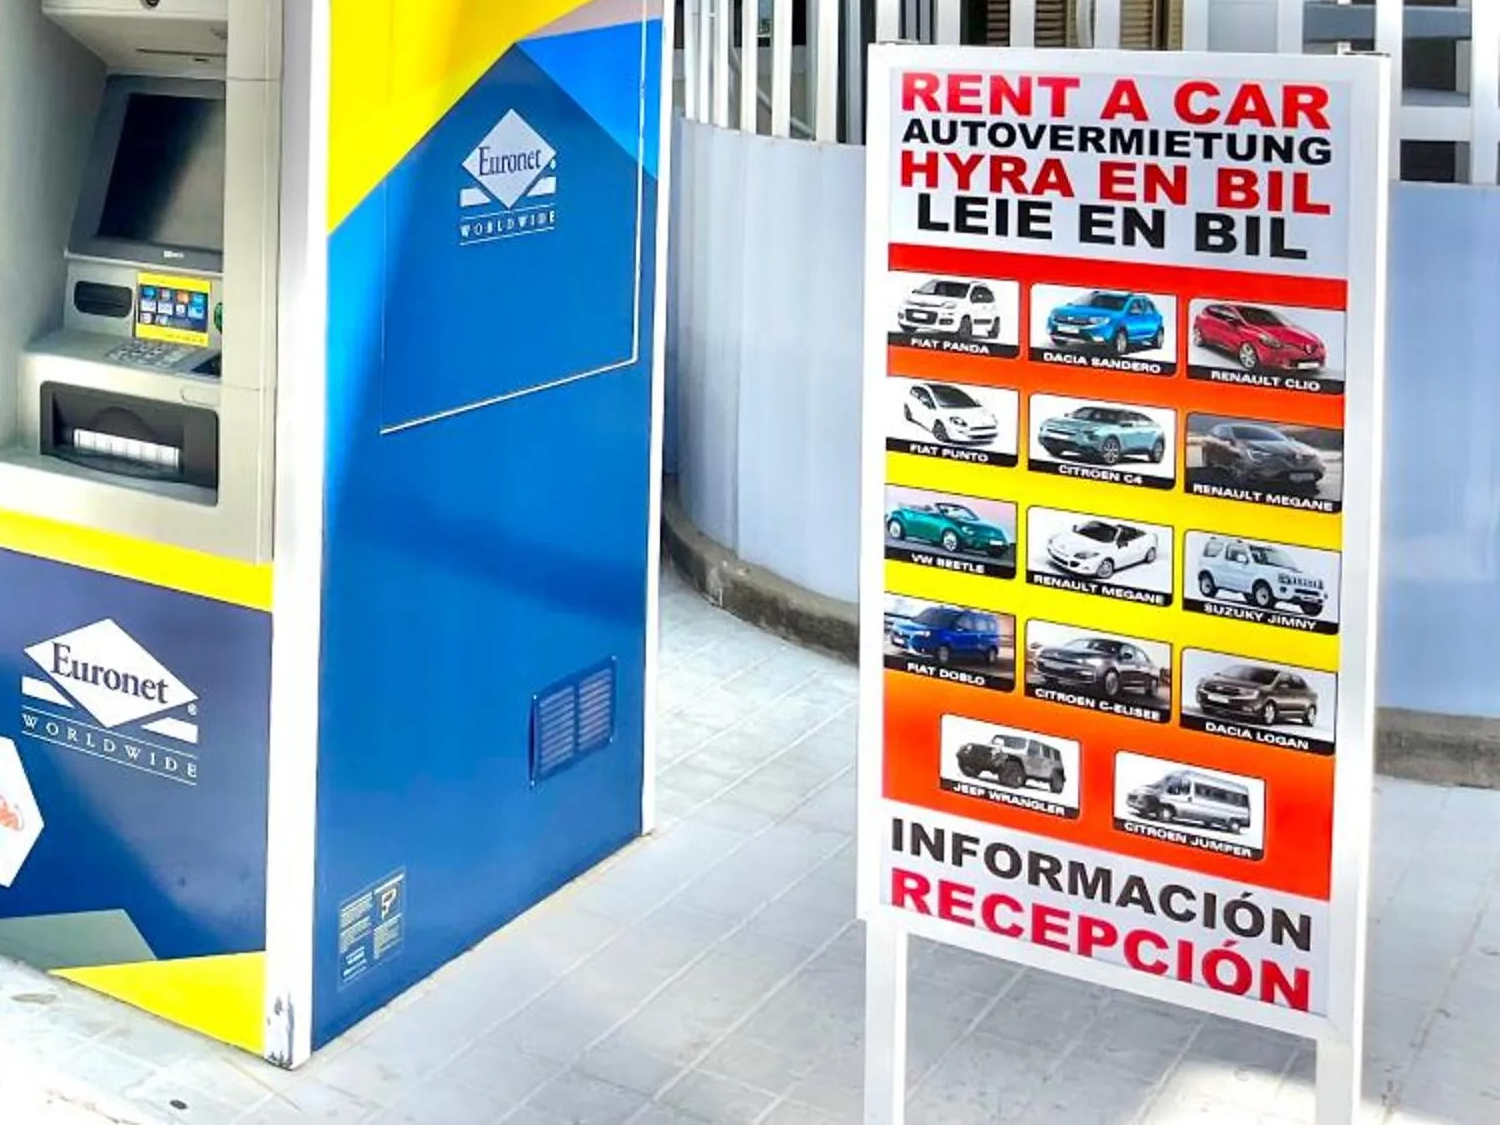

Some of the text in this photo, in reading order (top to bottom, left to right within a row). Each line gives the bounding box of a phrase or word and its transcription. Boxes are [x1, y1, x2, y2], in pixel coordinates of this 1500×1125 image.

[902, 72, 1332, 130] RENT A CAR
[902, 118, 1332, 165] AUTOVERMIETUNG
[478, 146, 541, 176] Euronet
[901, 150, 1331, 215] HYRA EN BIL
[917, 193, 1307, 259] LEIE EN BIL
[911, 336, 989, 355] FIAT PANDA
[1043, 351, 1161, 374] DACIA SANDERO
[1211, 369, 1321, 392] RENAULT CLIO
[910, 443, 989, 463] FIAT PUNTO
[1193, 482, 1333, 513] RENAULT MEGANE
[911, 552, 985, 575] VW BEETLE
[1033, 573, 1165, 606] RENAULT MEGANE
[1204, 602, 1317, 631] SUZUKY JIMNY
[50, 641, 169, 705] Euronet
[907, 662, 985, 686] FIAT DOBLO
[22, 713, 197, 778] WORLDWIDE
[1205, 721, 1310, 751] DACIA LOGAN
[952, 781, 1065, 817] JEEP WRANGLER
[1190, 832, 1253, 858] JUMPER
[890, 817, 1312, 952] INFORMACIÓN
[890, 866, 1311, 1014] RECEPCIÓN
